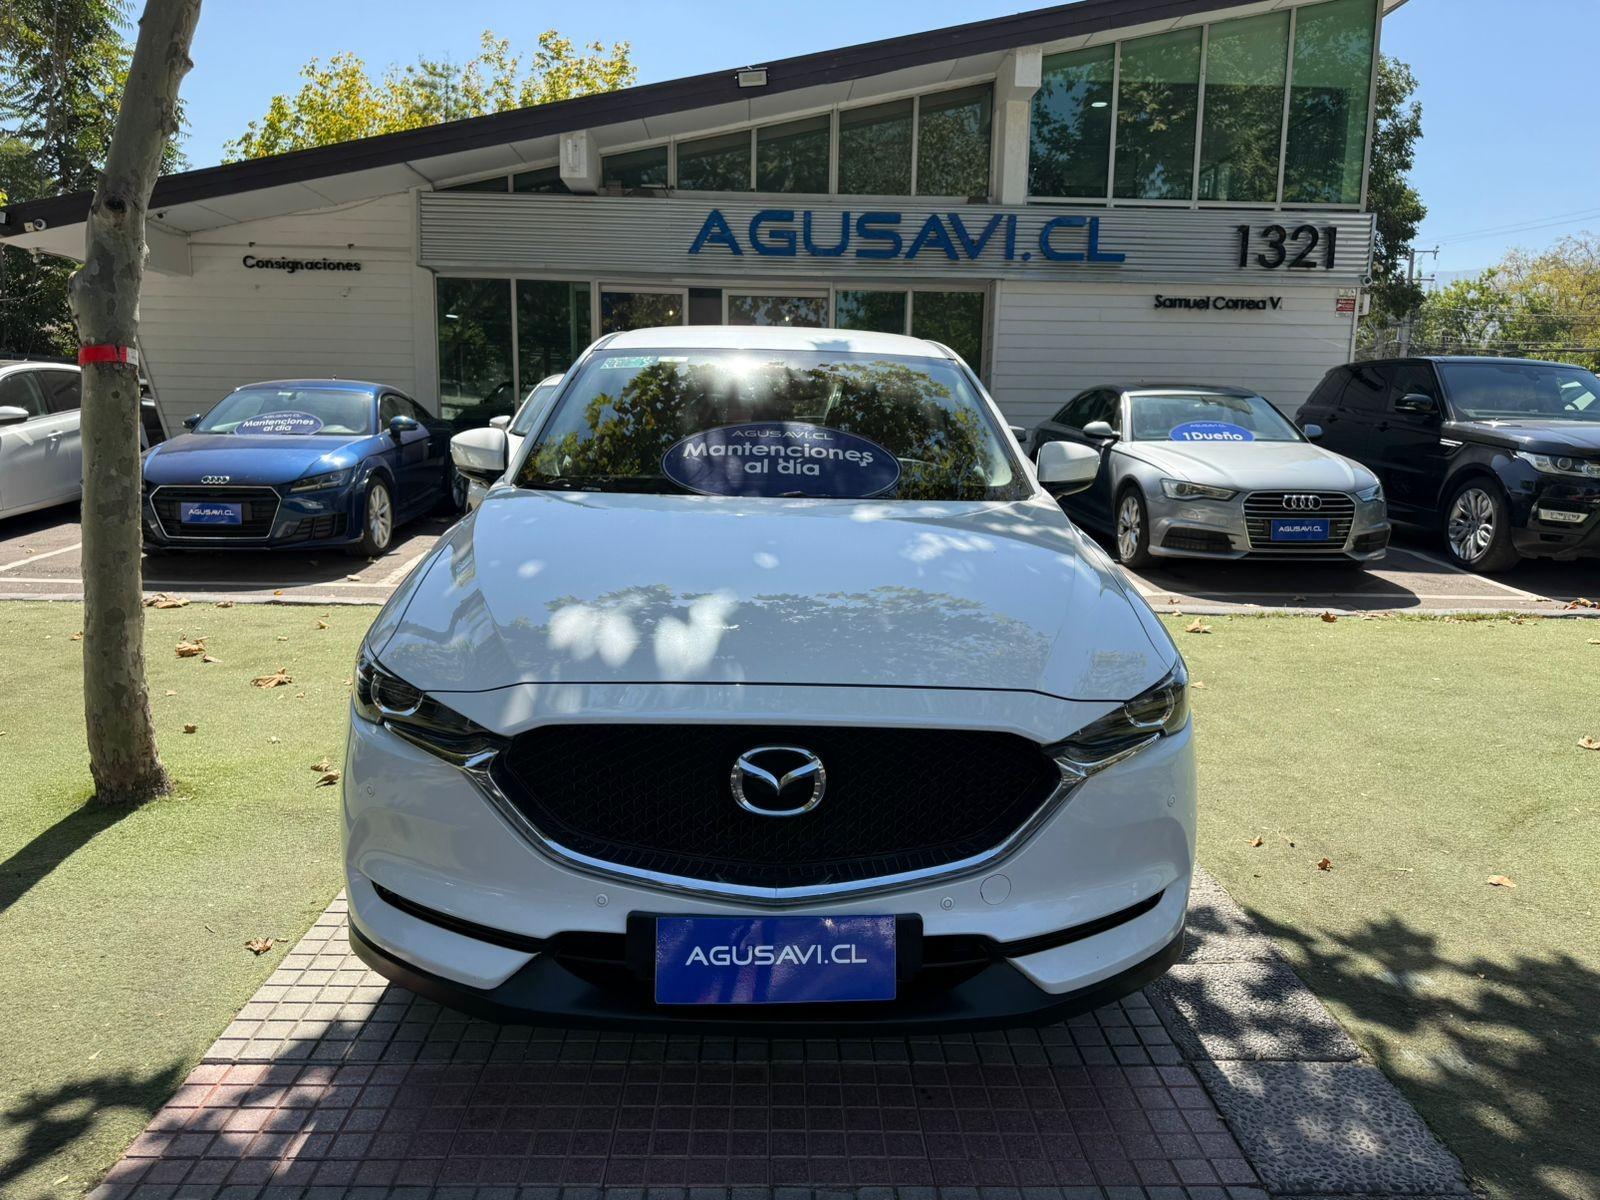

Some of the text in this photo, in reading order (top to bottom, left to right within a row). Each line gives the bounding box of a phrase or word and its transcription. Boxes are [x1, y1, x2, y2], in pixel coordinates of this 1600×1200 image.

[688, 208, 1125, 263] AGUSAVI.CL
[1237, 224, 1337, 269] 1321
[242, 255, 362, 274] Consignaciones
[1154, 294, 1210, 310] Samuel
[1213, 296, 1267, 310] Correa
[242, 417, 315, 428] Mantenciones
[731, 429, 834, 441] AGUSAVI.CL
[682, 442, 875, 464] Mantenciones
[744, 458, 820, 476] al día
[188, 508, 235, 516] AGUSAVI.CL
[1278, 525, 1323, 533] AGUSAVI.CL
[684, 943, 868, 967] AGUSAVI.CL
